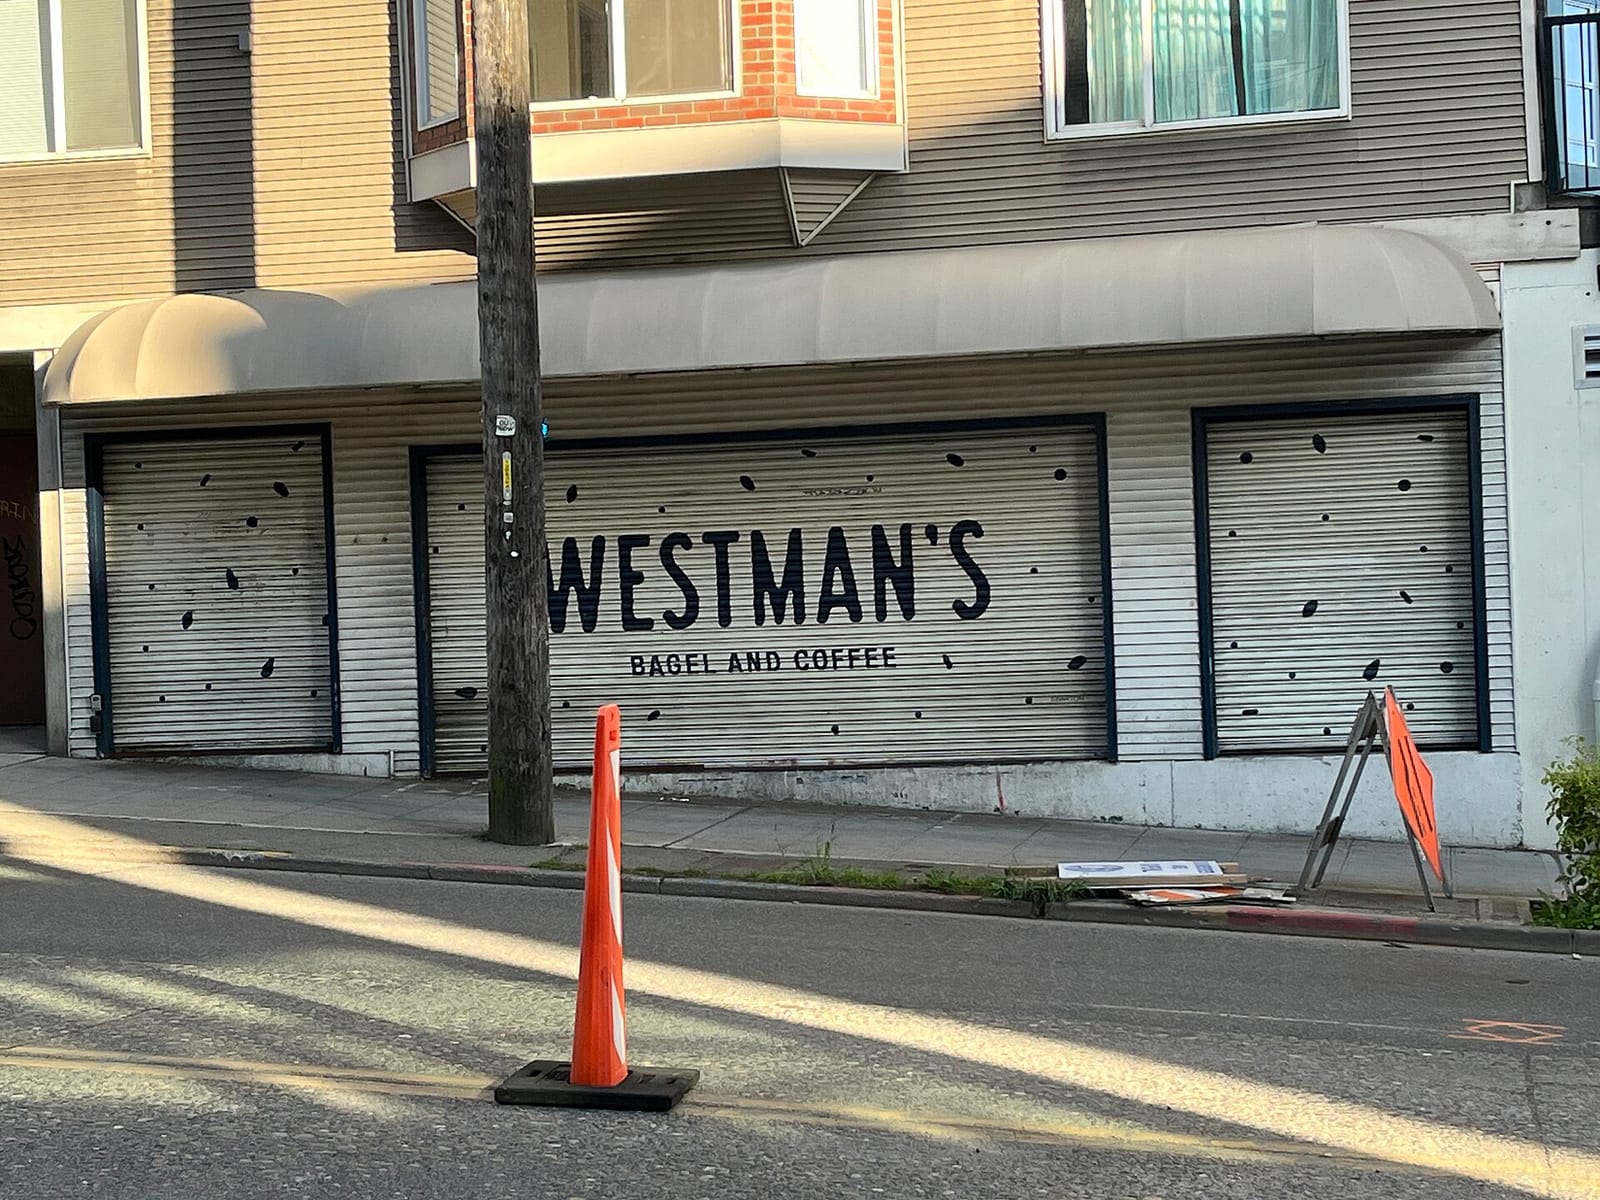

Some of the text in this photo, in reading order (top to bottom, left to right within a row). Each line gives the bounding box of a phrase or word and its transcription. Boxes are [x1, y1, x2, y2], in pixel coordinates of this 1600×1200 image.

[547, 519, 991, 634] WESTMAN'S
[630, 646, 897, 677] BAGEL AND COFFEE
